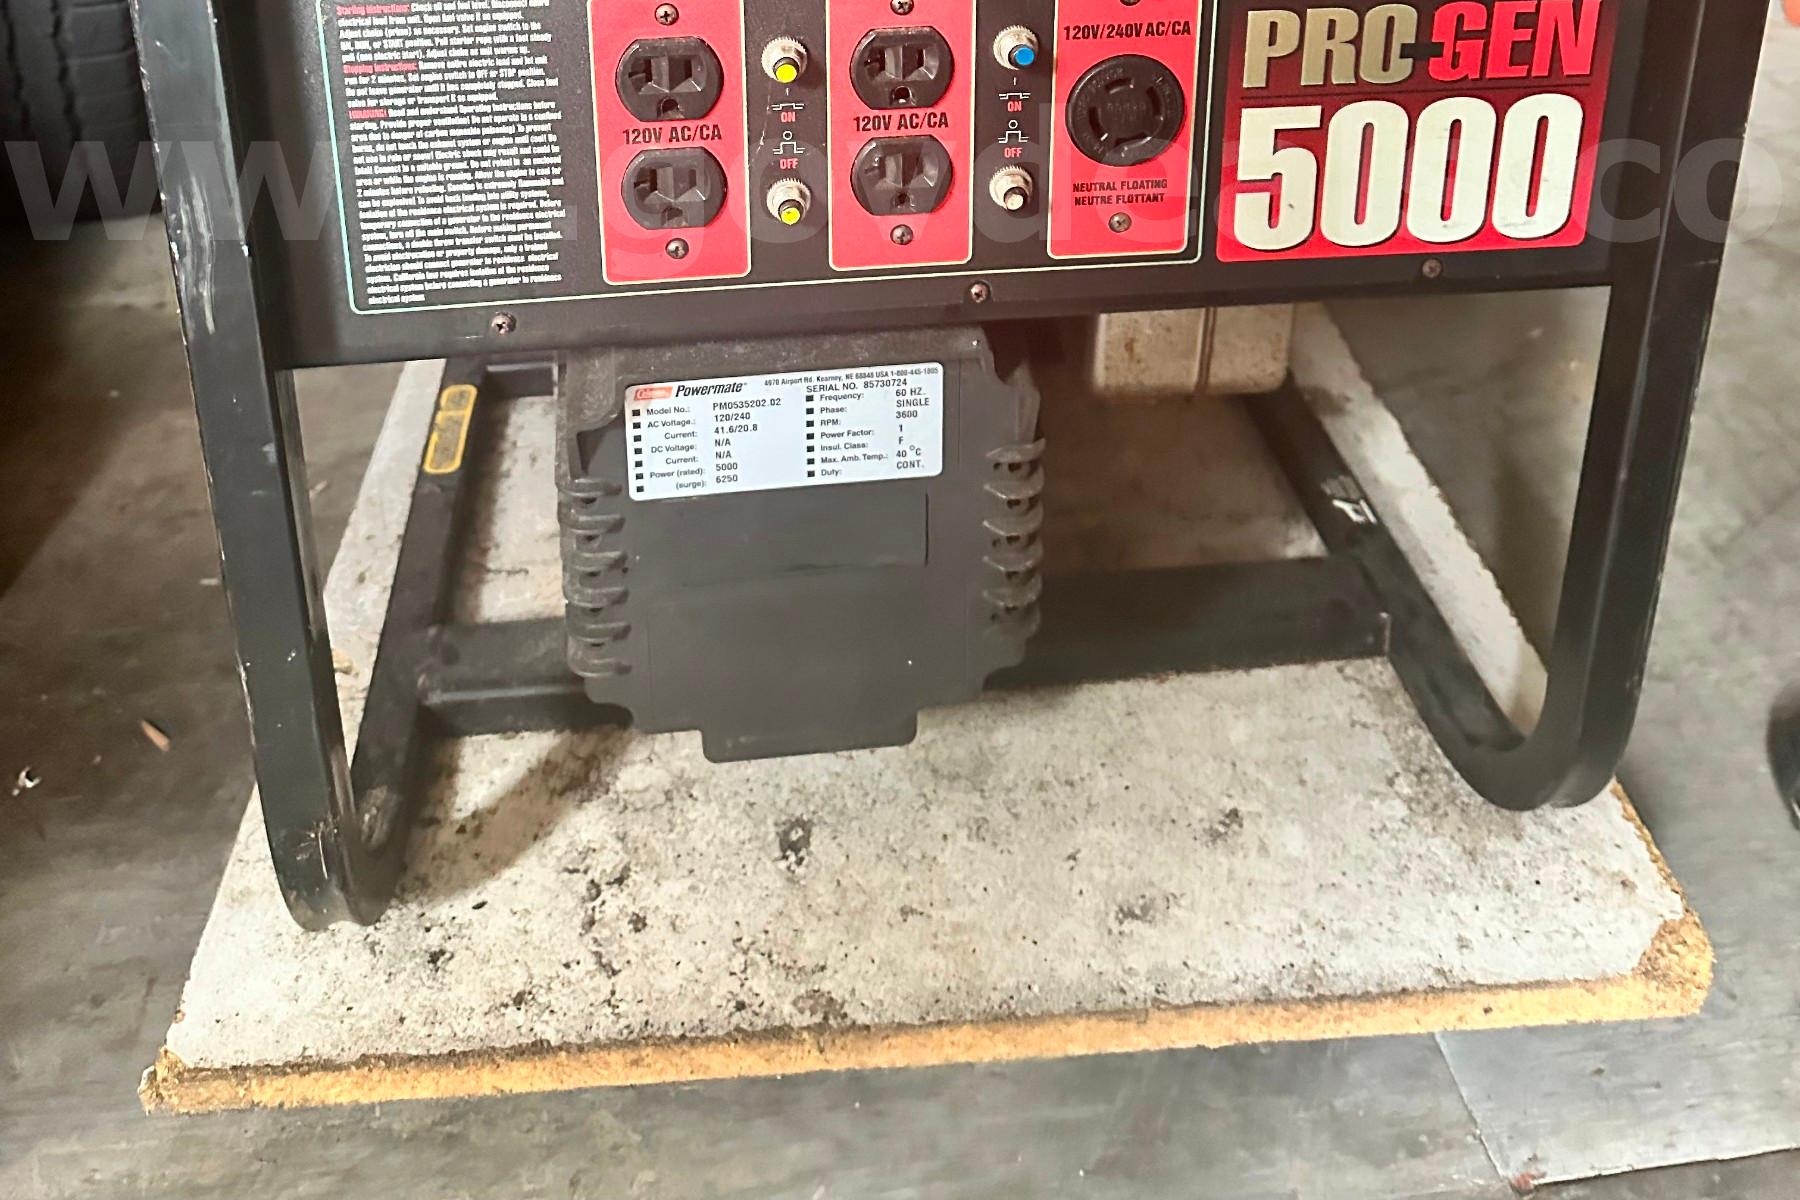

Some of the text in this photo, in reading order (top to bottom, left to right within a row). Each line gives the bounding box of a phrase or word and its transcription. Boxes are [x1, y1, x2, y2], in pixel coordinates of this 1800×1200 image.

[1064, 21, 1192, 40] 120V/240V AC/CA
[1007, 101, 1022, 112] ON
[781, 112, 796, 122] ON
[853, 112, 949, 132] 120V AC/CA
[623, 124, 723, 145] 120V AC/CA
[1004, 148, 1022, 158] OFF
[780, 158, 799, 170] OFF
[1234, 93, 1584, 250] 5000
[1073, 179, 1168, 192] NEUTRAL FLOATING
[1074, 193, 1165, 206] NEUTRE FLOTTANT
[781, 377, 802, 386] Airport
[846, 372, 853, 380] NE
[876, 370, 889, 378] USA
[806, 378, 907, 393] SERIAL NO. 85730724
[676, 381, 744, 398] Powermate
[820, 392, 864, 402] Frequency:
[896, 388, 907, 397] 60
[646, 407, 672, 416] Model
[713, 398, 781, 411] PM0535202.02
[820, 398, 930, 414] Phase: SINGLE
[648, 420, 660, 429] AC
[714, 412, 751, 423] 120/240
[820, 410, 918, 426] RPM: 3600
[664, 424, 758, 440] Current: 41.6/20.8
[820, 424, 903, 439] Power Factor: 1
[651, 438, 731, 454] DC Voltage: N/A
[820, 437, 904, 452] Insul. Class: F
[665, 450, 732, 465] Current: N/A
[821, 456, 839, 464] Max.
[841, 454, 861, 463] Amb.
[896, 449, 907, 458] 40
[650, 470, 674, 479] Power
[715, 462, 738, 472] 5000
[821, 460, 924, 477] Duty: CONT.
[715, 474, 738, 484] 6250
